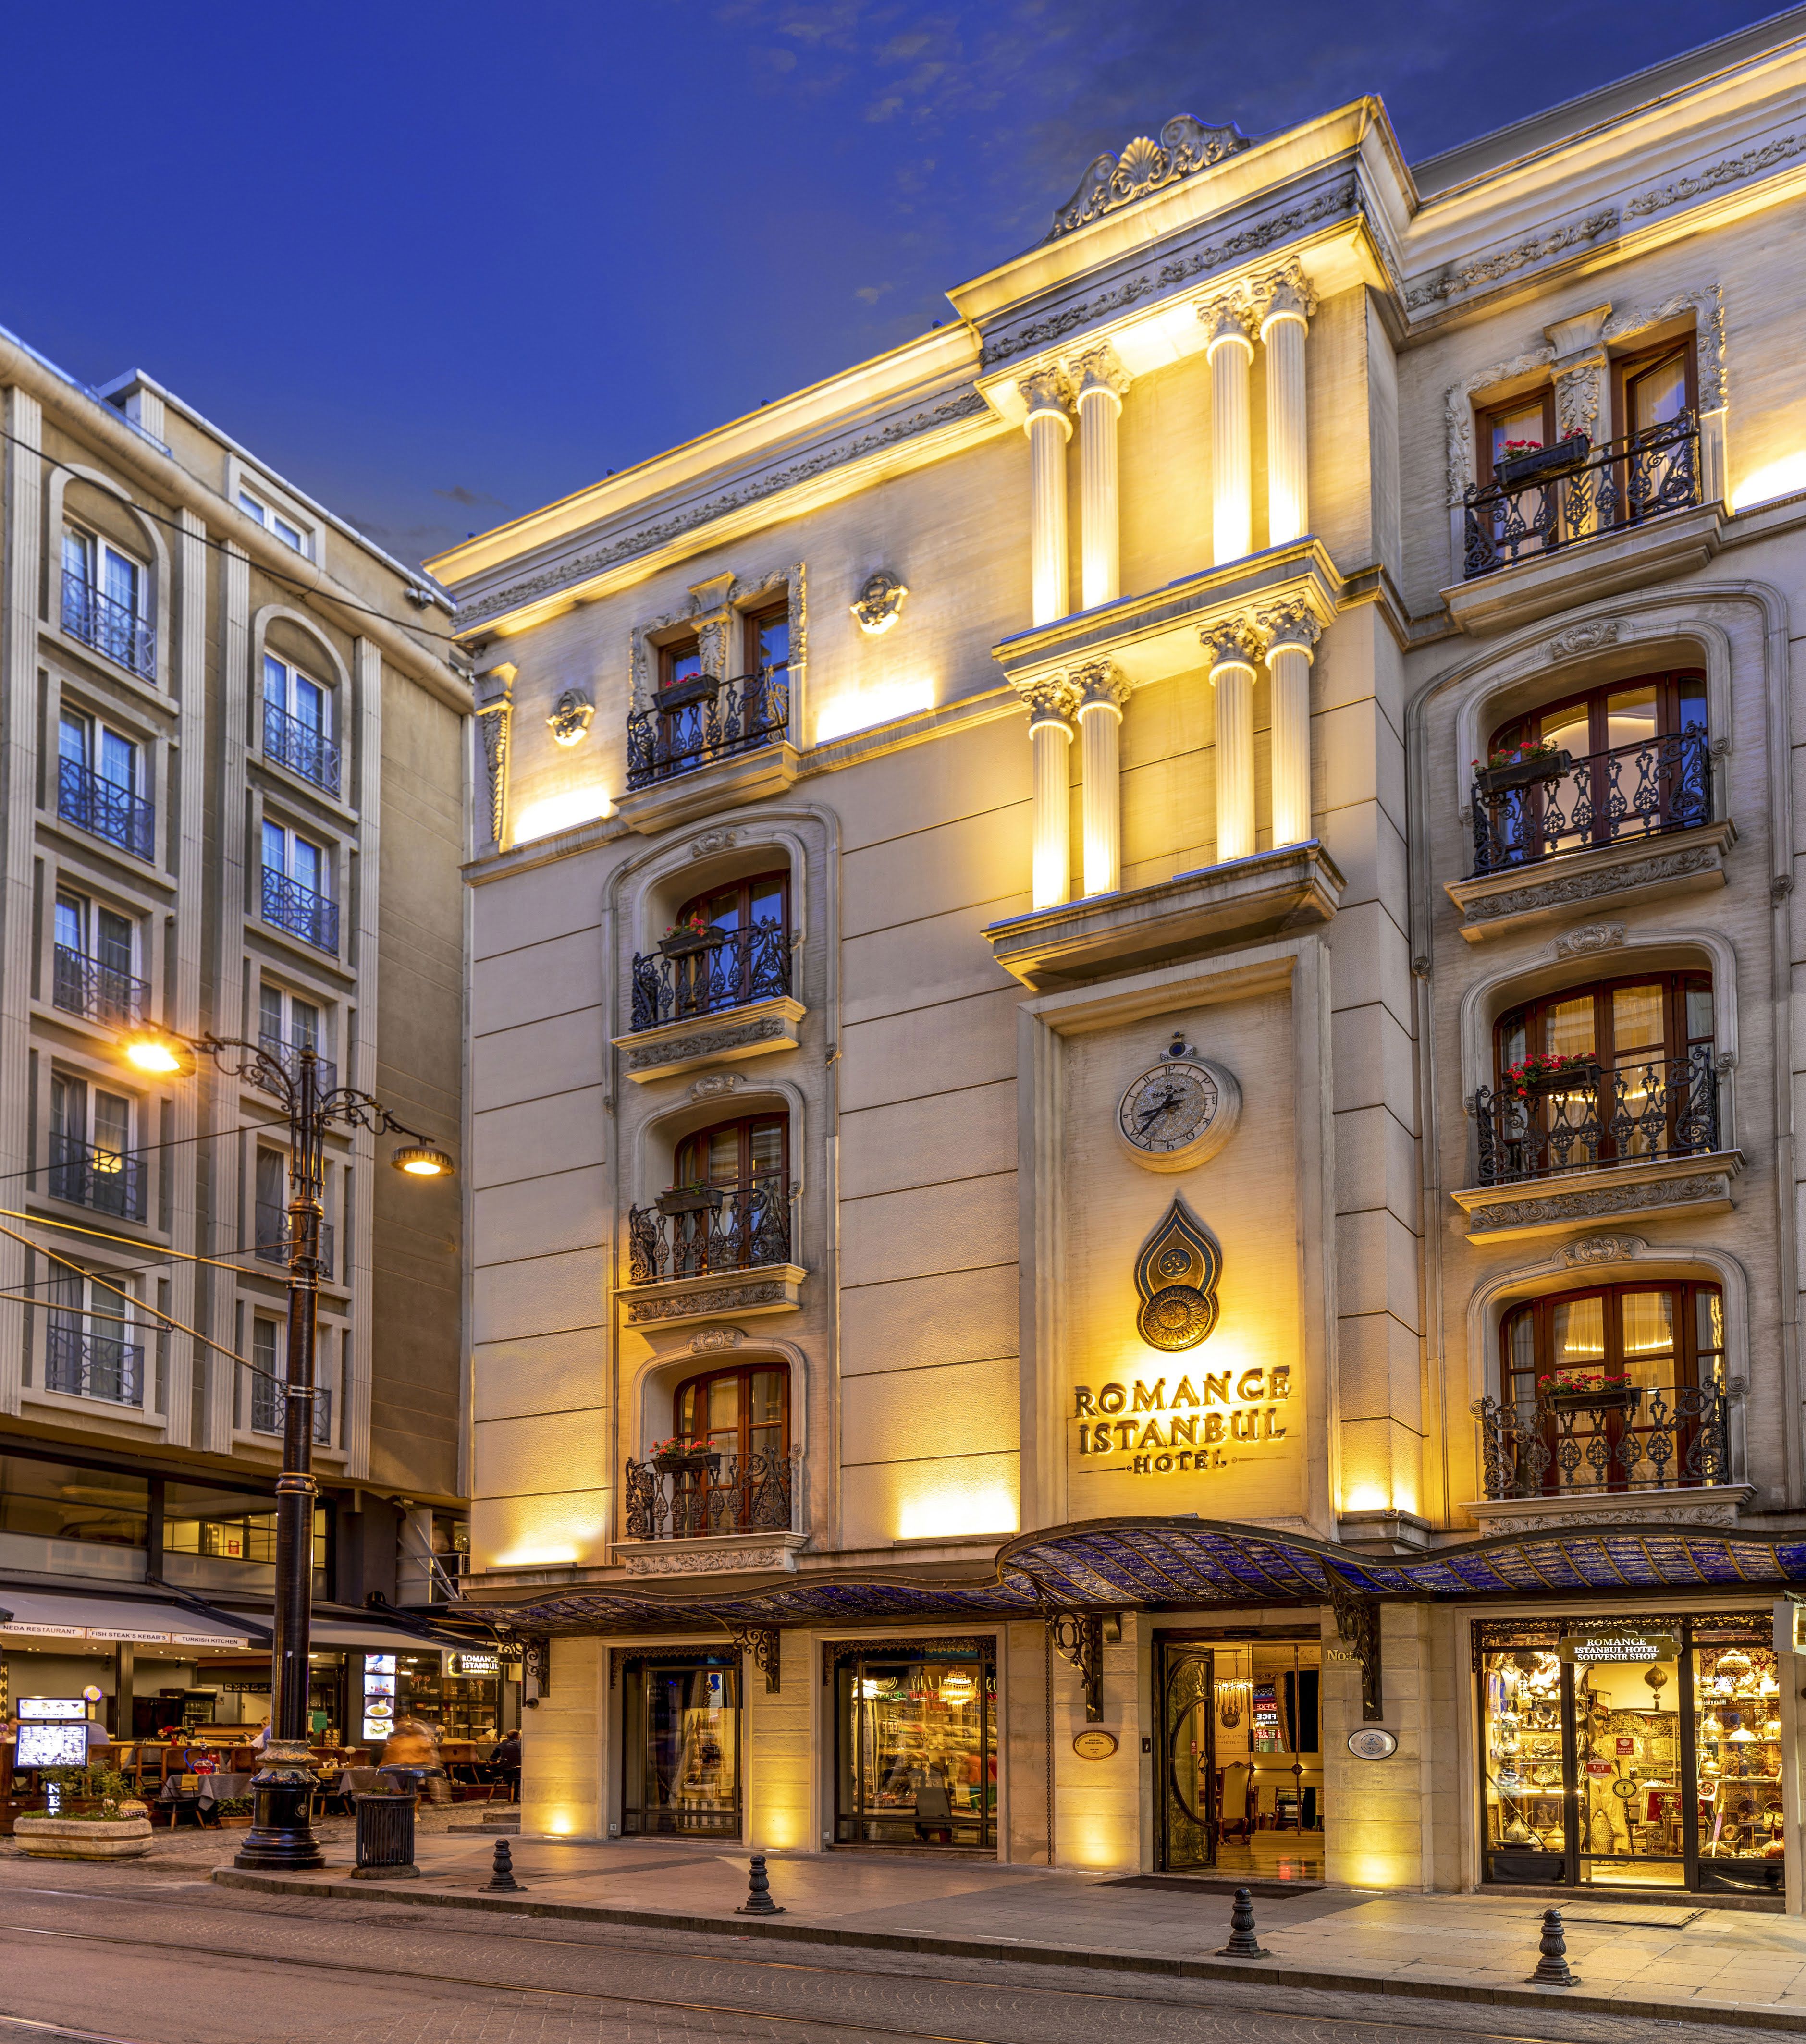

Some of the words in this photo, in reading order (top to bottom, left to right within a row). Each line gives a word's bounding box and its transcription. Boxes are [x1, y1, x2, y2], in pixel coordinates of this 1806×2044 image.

[1074, 1369, 1290, 1419] ROMANCE
[1133, 1451, 1226, 1475] HOTEL
[26, 1626, 76, 1634] RESTAURANT
[1586, 1638, 1647, 1646] ROMANCE
